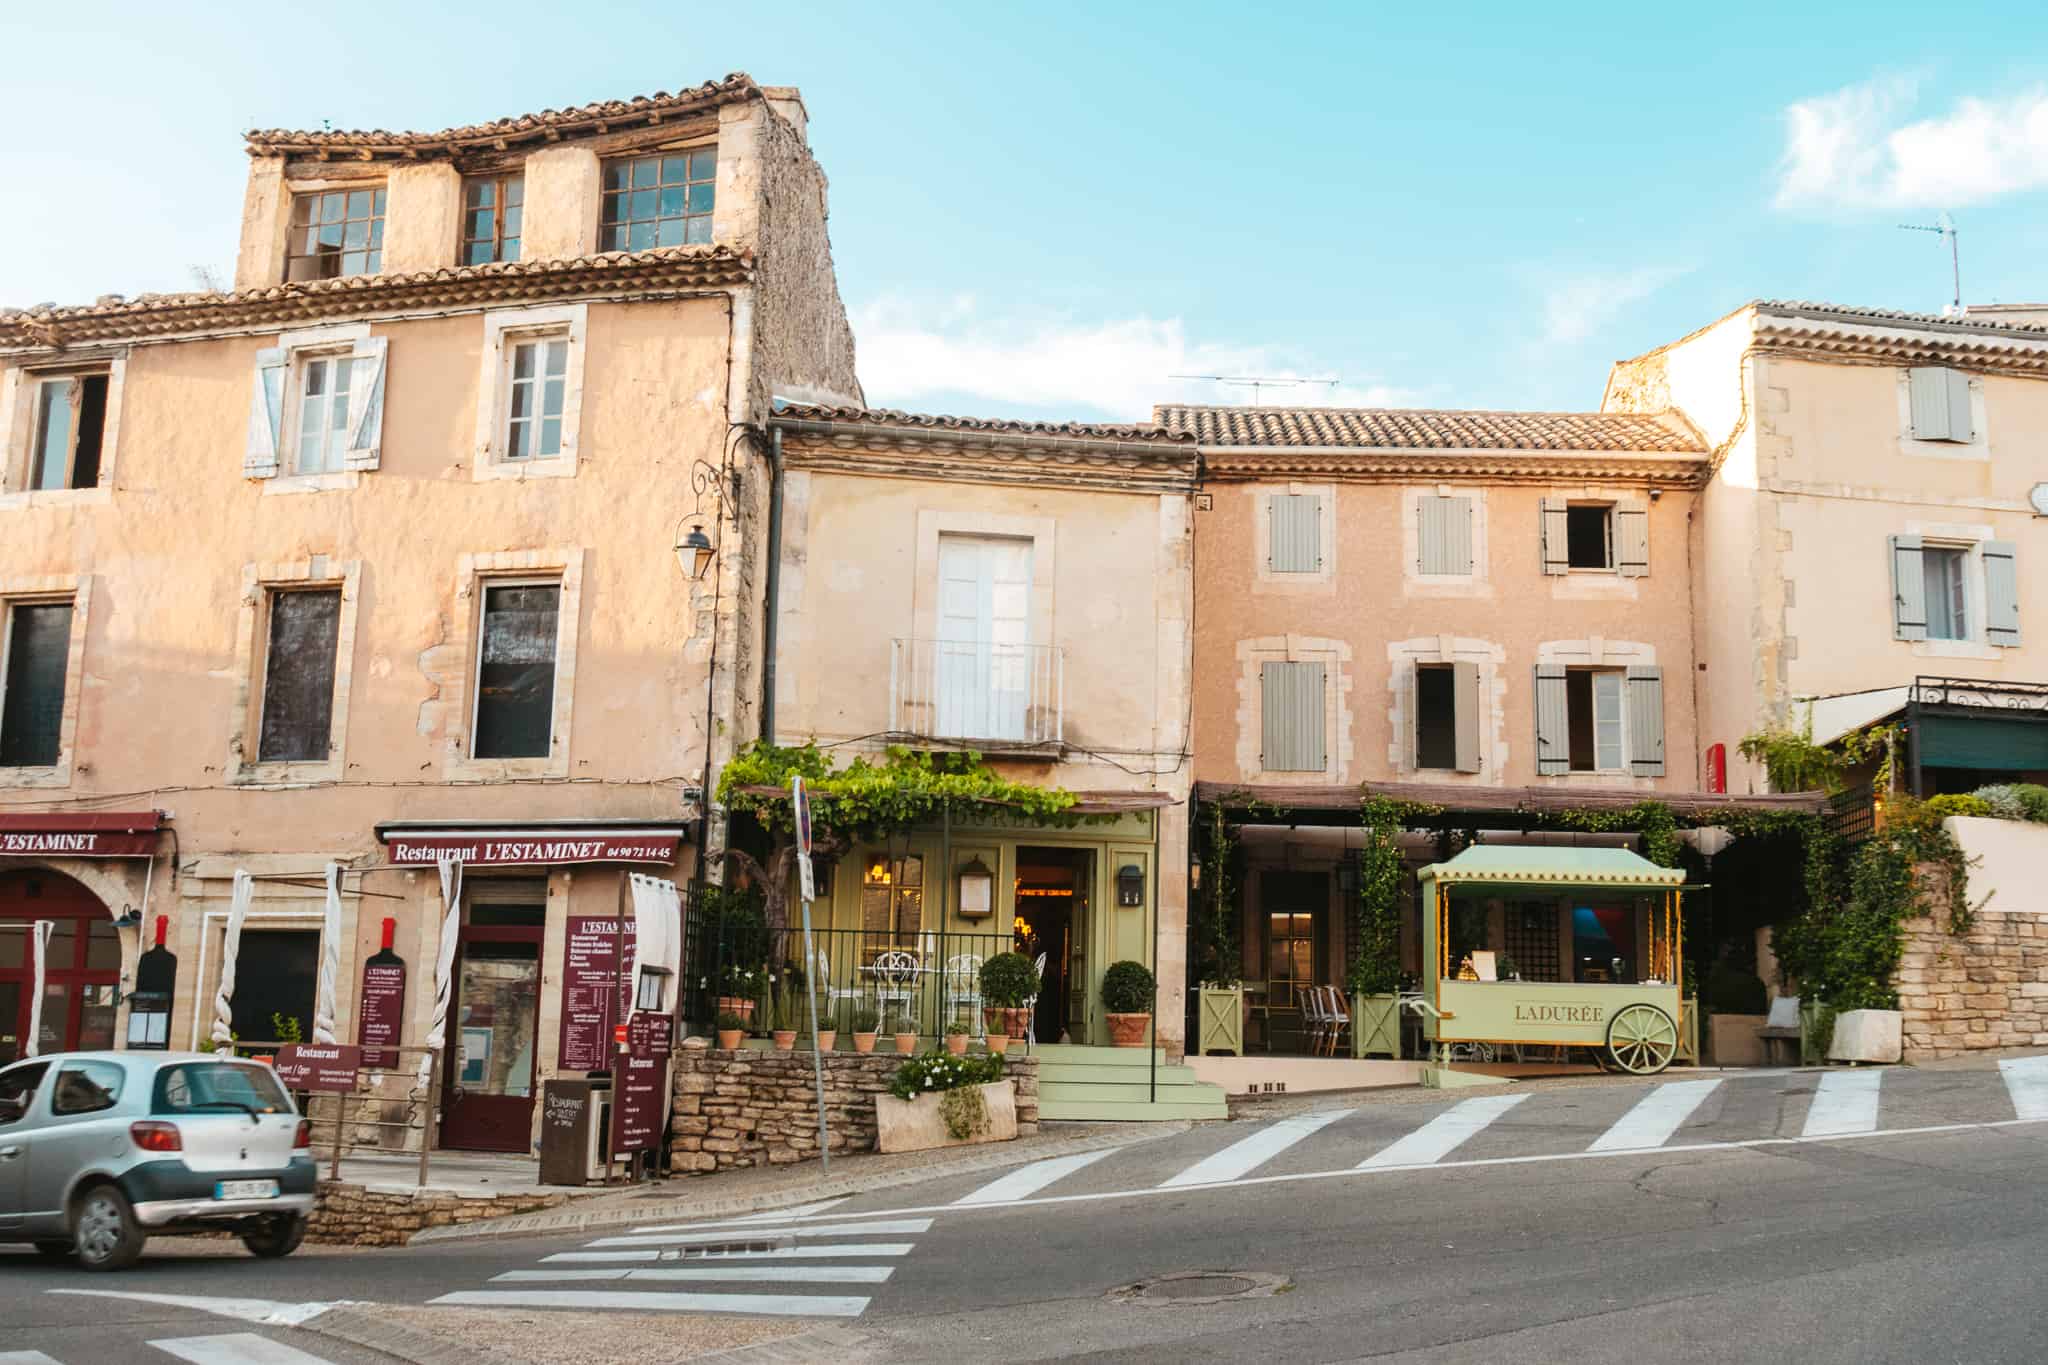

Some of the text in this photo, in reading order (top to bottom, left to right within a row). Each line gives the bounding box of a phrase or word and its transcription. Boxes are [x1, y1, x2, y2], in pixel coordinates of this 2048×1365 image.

[0, 834, 97, 850] 'ESTAMINET
[395, 844, 477, 861] Restaurant
[485, 841, 605, 860] L'ESTAMINET
[1514, 1004, 1604, 1021] LADURÉE
[296, 1046, 340, 1059] Restaurant
